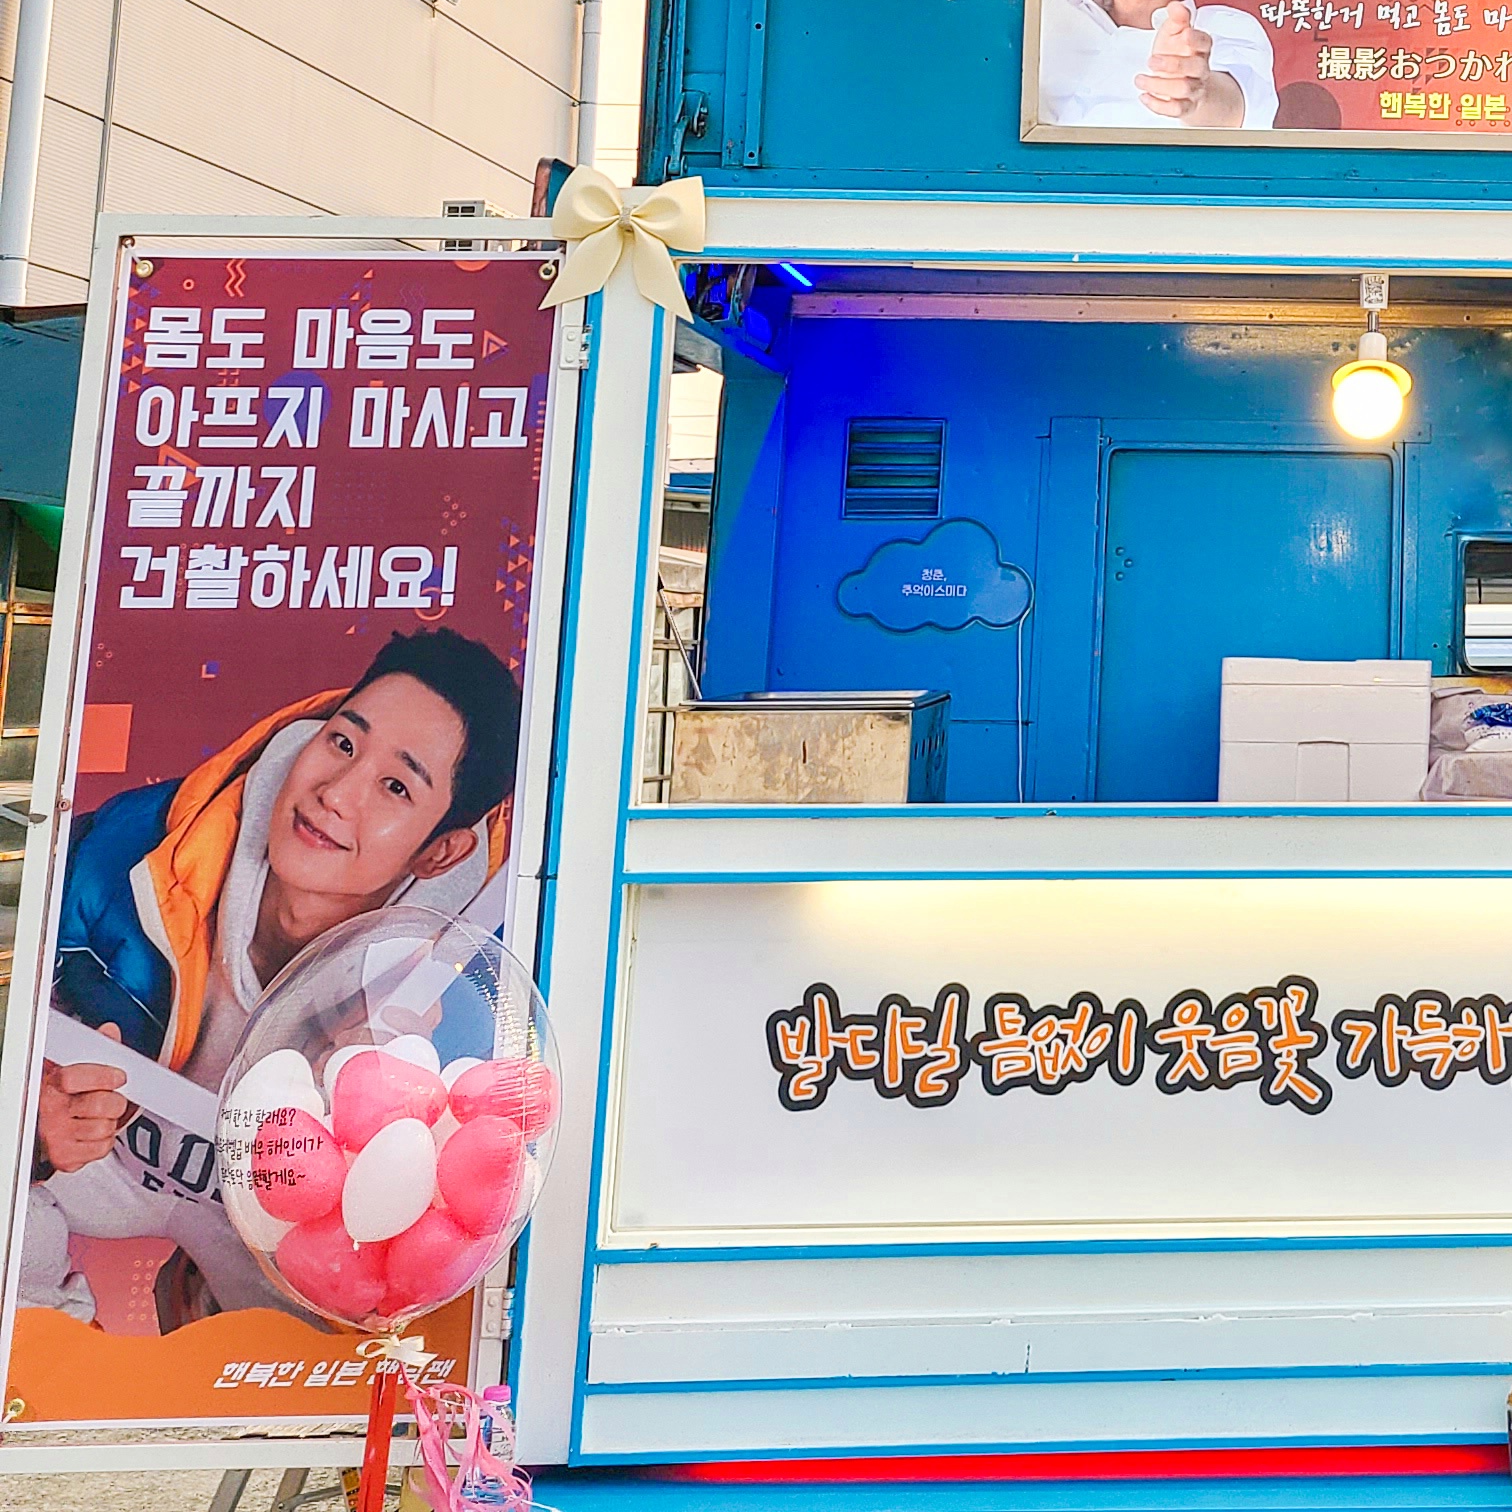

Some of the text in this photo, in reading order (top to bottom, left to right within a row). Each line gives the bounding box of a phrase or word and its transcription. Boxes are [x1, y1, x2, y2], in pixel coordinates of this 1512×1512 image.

[1376, 1, 1422, 30] 먹고
[1433, 0, 1471, 36] 몸도
[1379, 92, 1451, 121] 핸복한
[1459, 94, 1507, 122] 일본
[143, 307, 476, 370] 몸도 마음도
[135, 386, 529, 449] 아프지 마시고
[126, 465, 316, 529] 끝까지
[118, 543, 460, 610] 건촬하세요!
[770, 986, 968, 1108] 발디딜
[973, 994, 1145, 1094] 틈없이
[1152, 977, 1330, 1112] 웃음꽃
[255, 1108, 297, 1131] 할래요?
[266, 1136, 323, 1157] 해인이가
[303, 1360, 366, 1387] 일본
